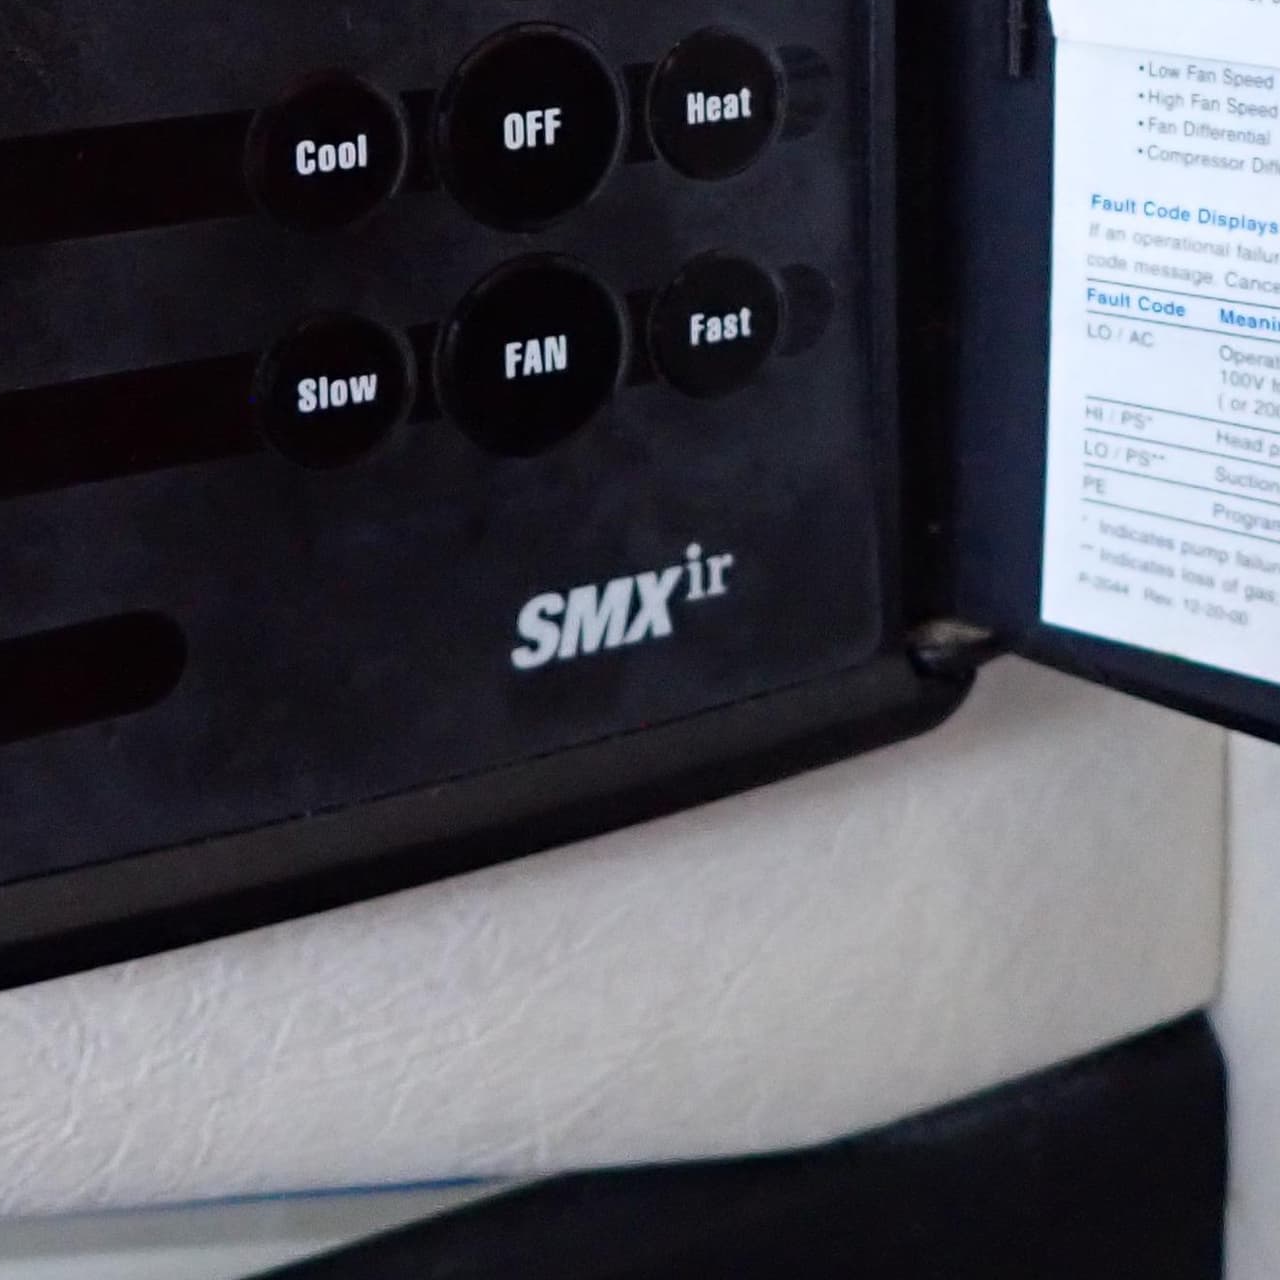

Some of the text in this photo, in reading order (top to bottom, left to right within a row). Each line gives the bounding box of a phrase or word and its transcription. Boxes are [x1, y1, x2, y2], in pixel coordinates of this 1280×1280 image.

[1147, 61, 1276, 91] Low Fan Speed
[1147, 89, 1280, 119] High Fan Speed
[295, 87, 752, 176] Cool OFF Heat
[1147, 116, 1272, 146] Fan Differential
[1146, 147, 1247, 171] Compressor
[1090, 193, 1280, 236] Fault Code Displays
[1085, 288, 1187, 317] Fault Code
[297, 307, 752, 413] Slow FAN Fast
